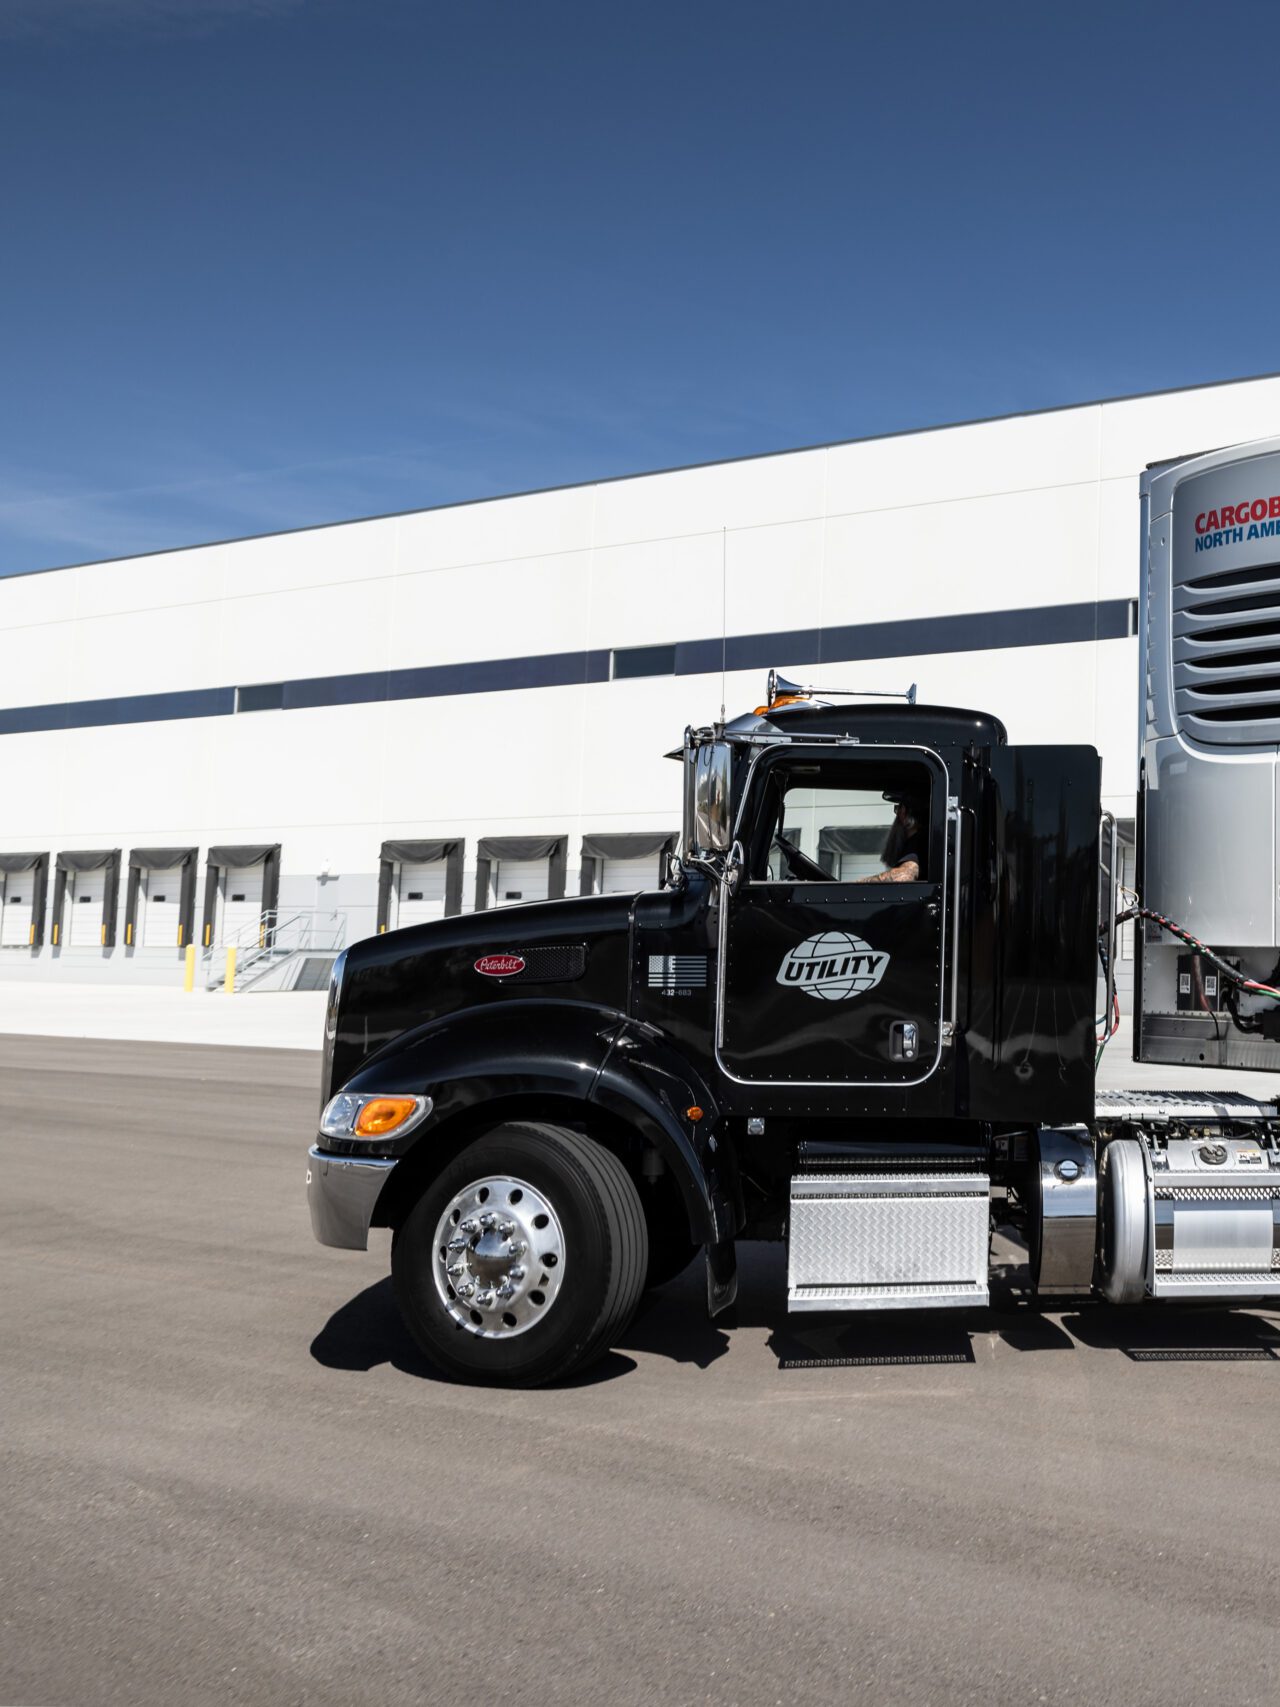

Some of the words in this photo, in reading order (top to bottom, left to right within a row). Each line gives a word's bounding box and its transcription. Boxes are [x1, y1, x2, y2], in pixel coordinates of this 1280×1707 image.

[1195, 526, 1243, 552] NORTH
[480, 958, 519, 971] Peterbilt
[785, 955, 884, 982] UTILITY
